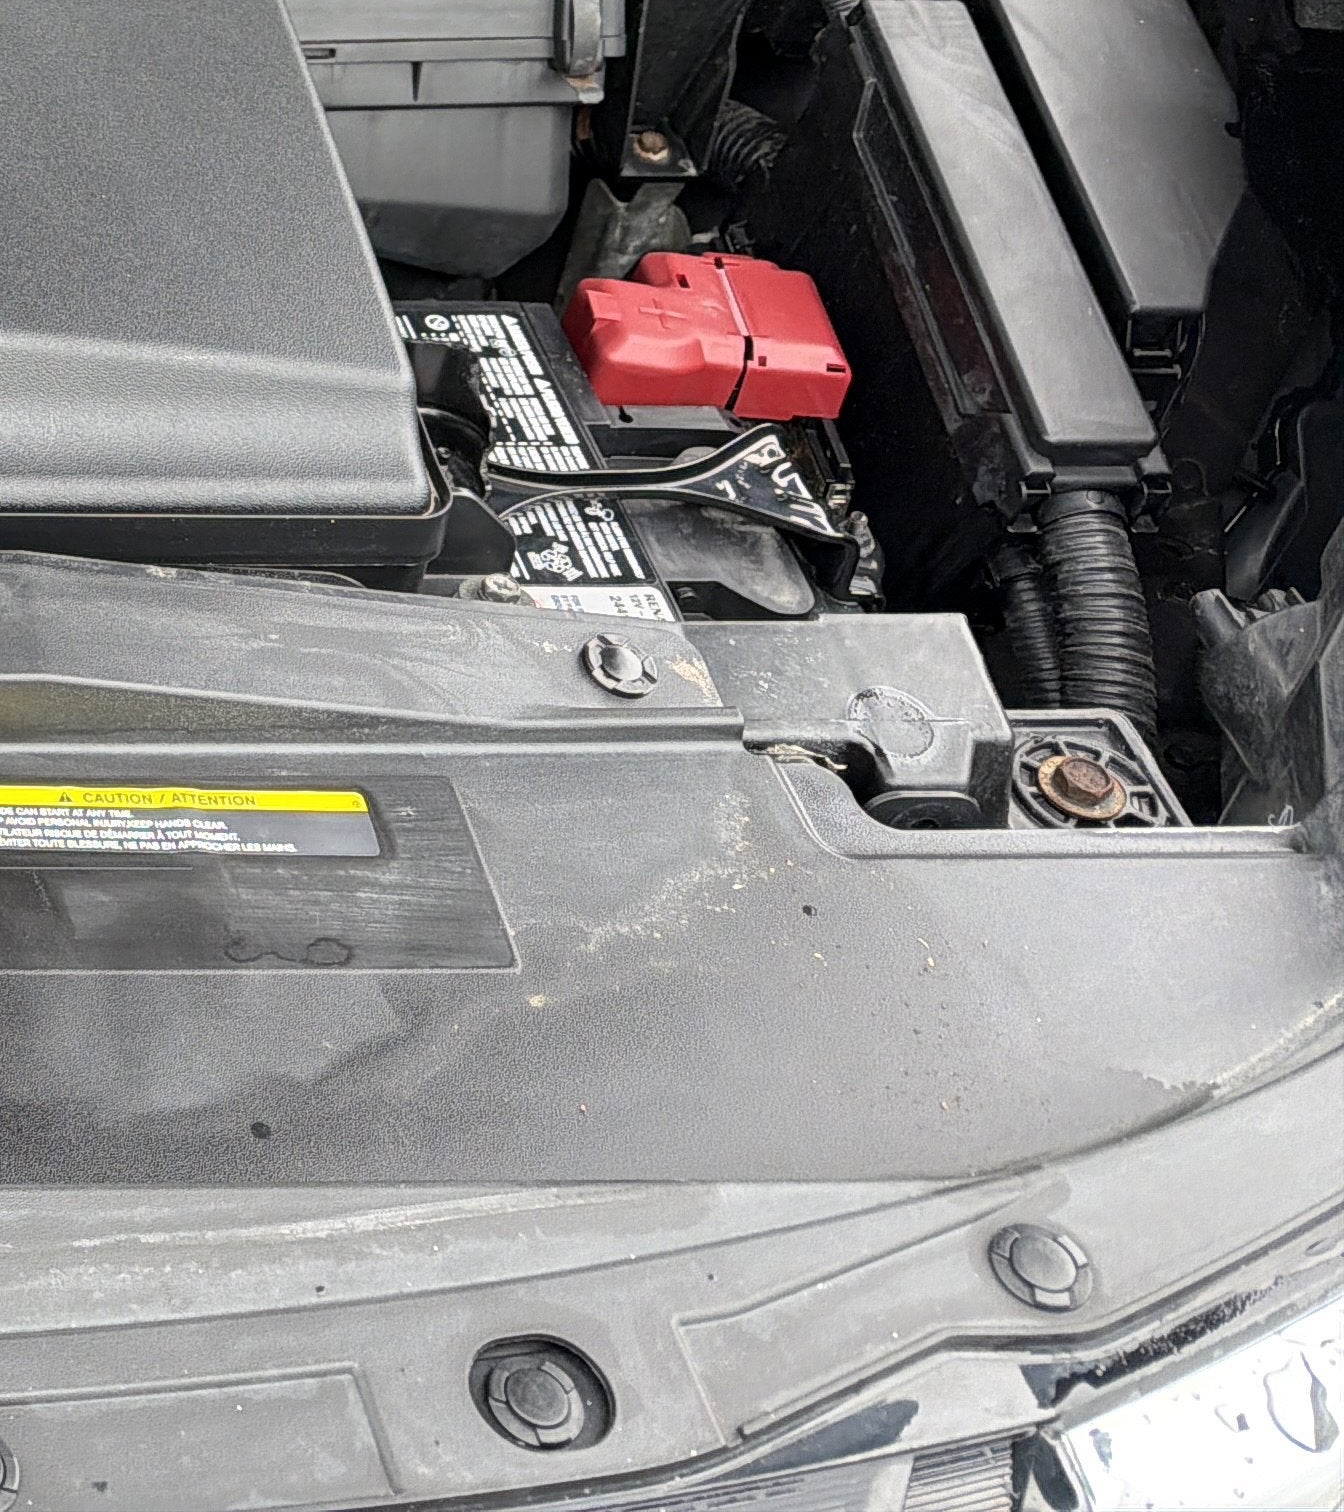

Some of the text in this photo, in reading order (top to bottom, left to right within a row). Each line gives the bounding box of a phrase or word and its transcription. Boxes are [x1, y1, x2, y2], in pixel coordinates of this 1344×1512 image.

[83, 792, 153, 804] CAUTION
[172, 793, 256, 805] ATTENTION
[15, 807, 38, 816] CAN
[39, 808, 70, 817] START
[72, 809, 84, 817] AT
[85, 809, 106, 818] ANY
[107, 809, 134, 819] TIME.
[6, 817, 36, 826] AVOID
[37, 818, 92, 827] PERSONAL
[154, 819, 191, 828] HANDS
[192, 819, 229, 829] CLEAR.
